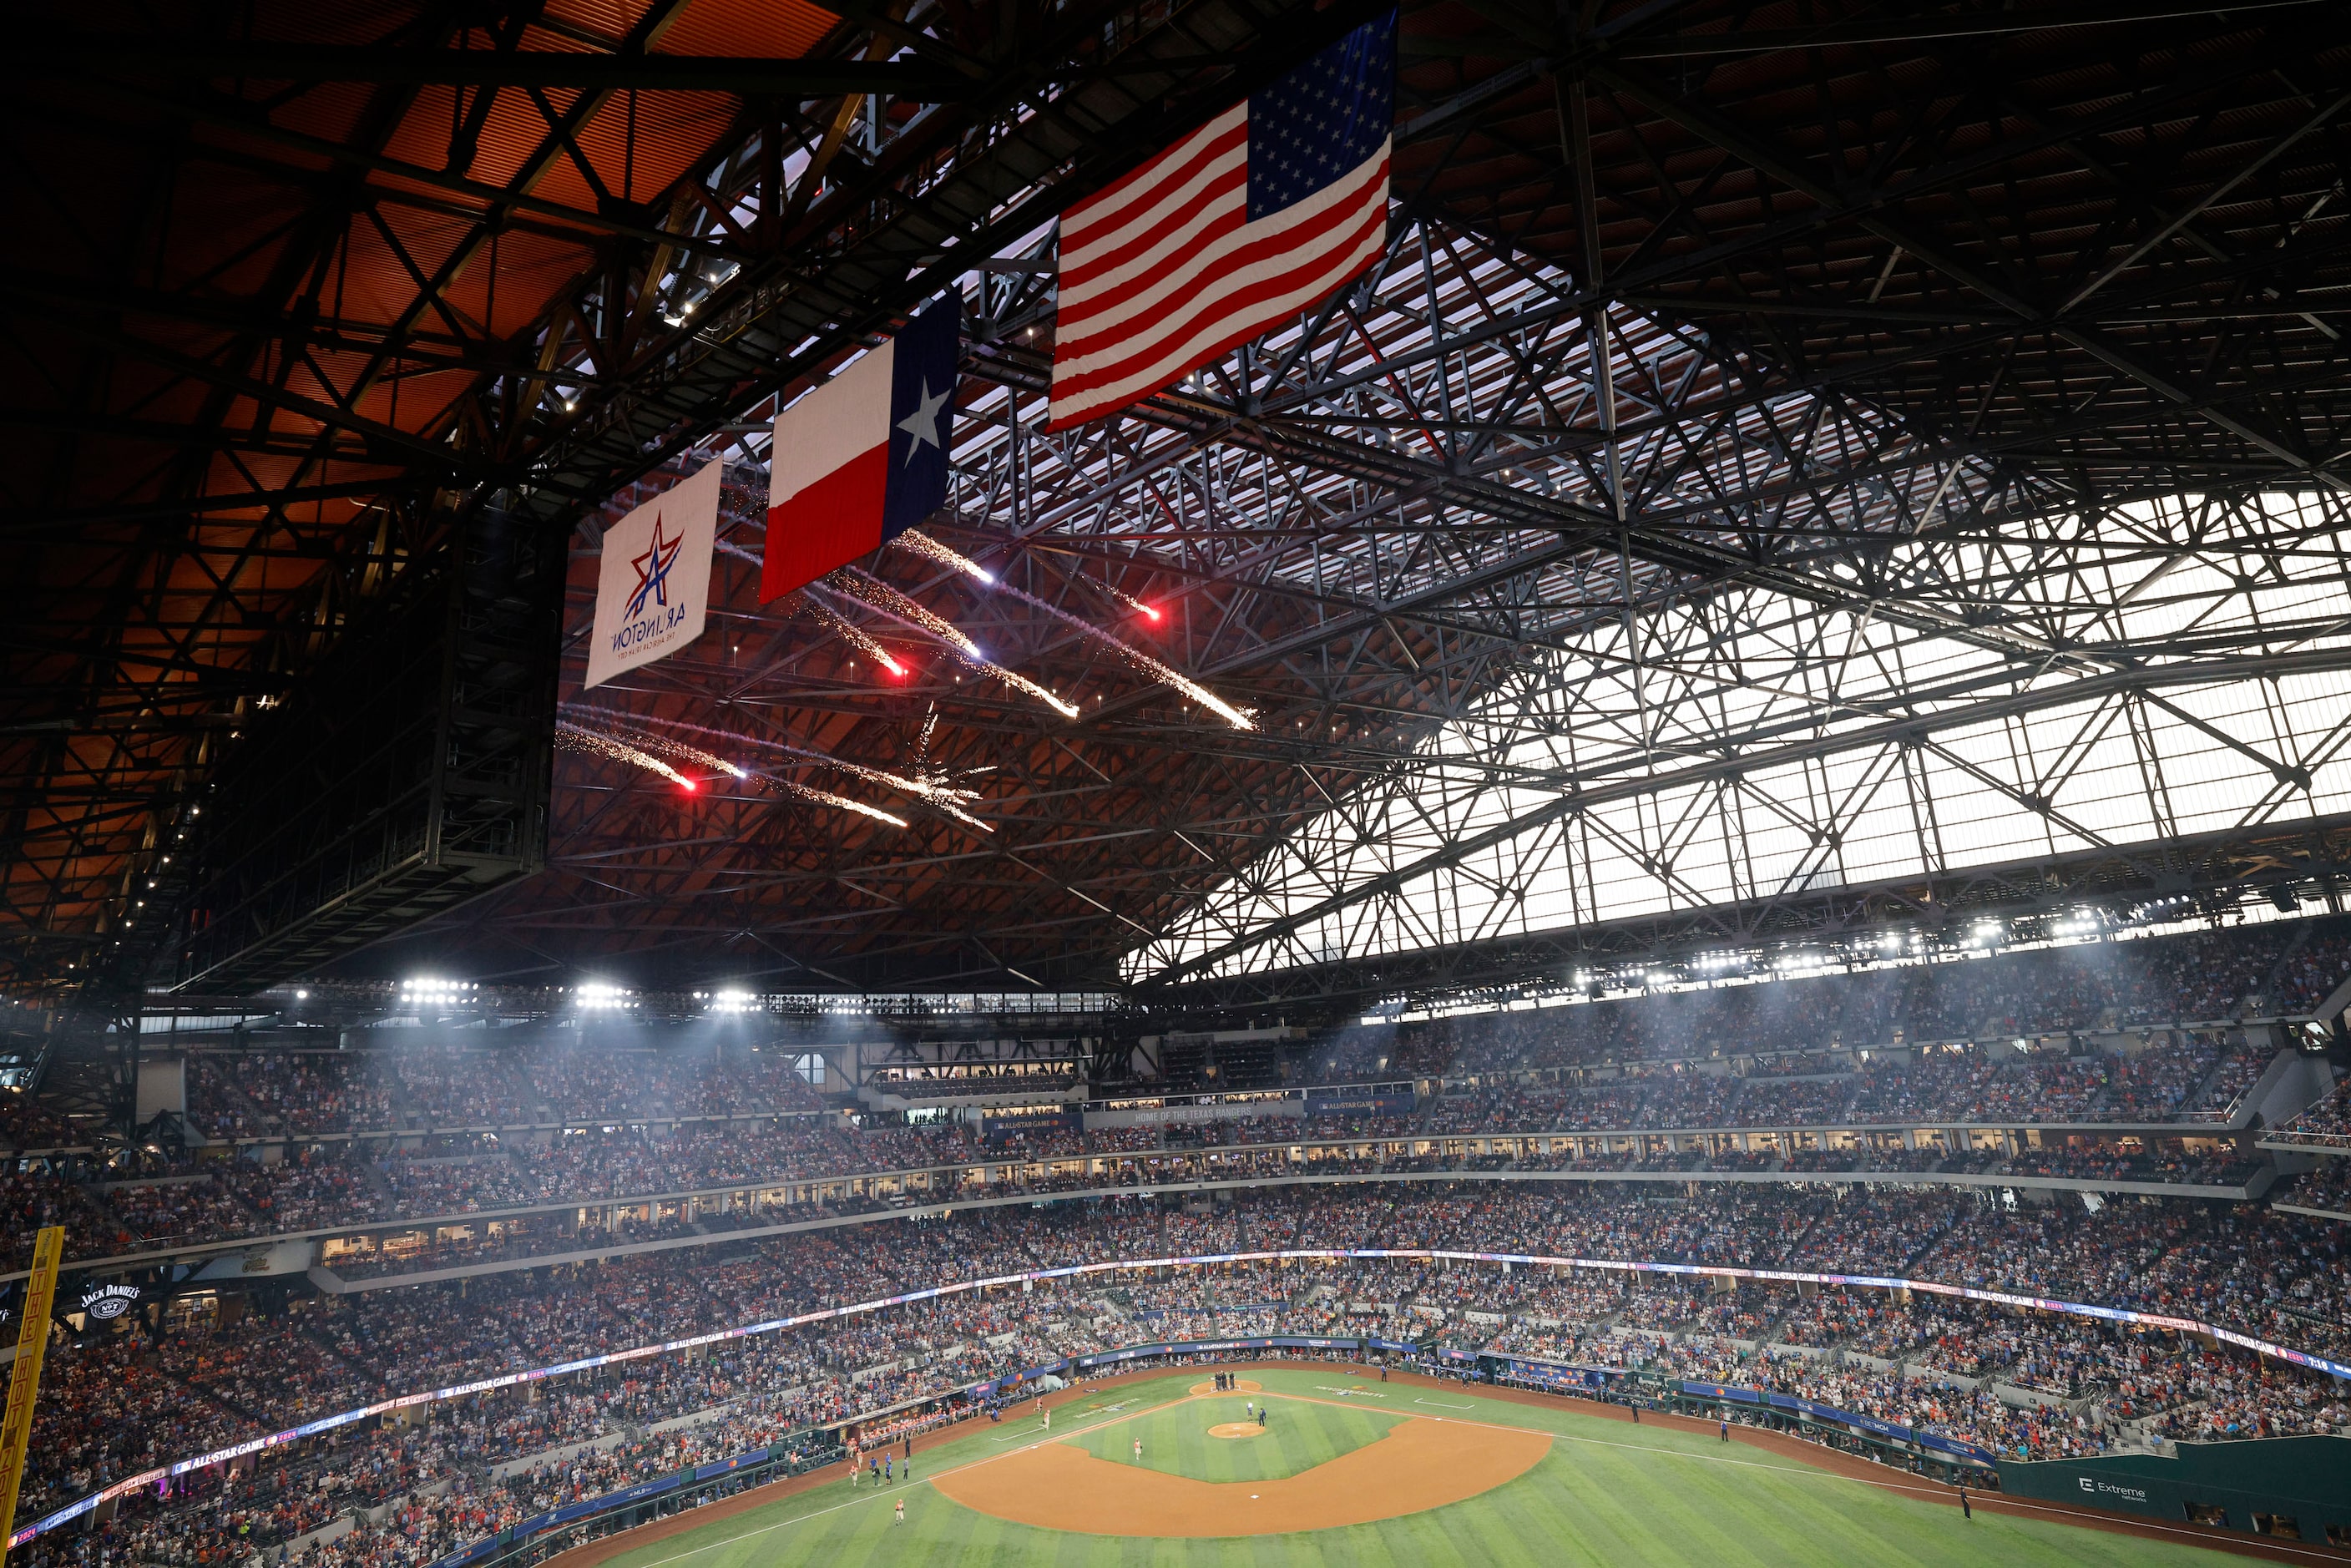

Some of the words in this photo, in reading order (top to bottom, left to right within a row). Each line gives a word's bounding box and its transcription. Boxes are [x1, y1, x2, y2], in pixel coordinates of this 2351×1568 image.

[1135, 1112, 1157, 1122] HOME
[1160, 1111, 1170, 1120] OF
[1172, 1110, 1187, 1120] THE
[1190, 1109, 1213, 1119] TEXAS
[1216, 1106, 1251, 1117] RANGERS
[1798, 1273, 1819, 1282] GAME
[26, 1272, 44, 1339] THE
[82, 1289, 104, 1308] JACK
[2012, 1295, 2035, 1307] GAME
[2151, 1318, 2184, 1327] AMERICAN
[706, 1332, 725, 1343] GAME
[2256, 1341, 2278, 1356] GAME
[2288, 1351, 2305, 1363] 2024
[493, 1375, 517, 1388] GAME
[12, 1357, 28, 1427] HOT
[237, 1439, 265, 1455] GAME
[279, 1431, 296, 1442] 2024
[138, 1470, 164, 1485] LEAGUE
[2097, 1482, 2146, 1498] Extreme
[2121, 1495, 2147, 1503] networks
[18, 1527, 36, 1541] 2024
[48, 1510, 73, 1527] NATIONAL
